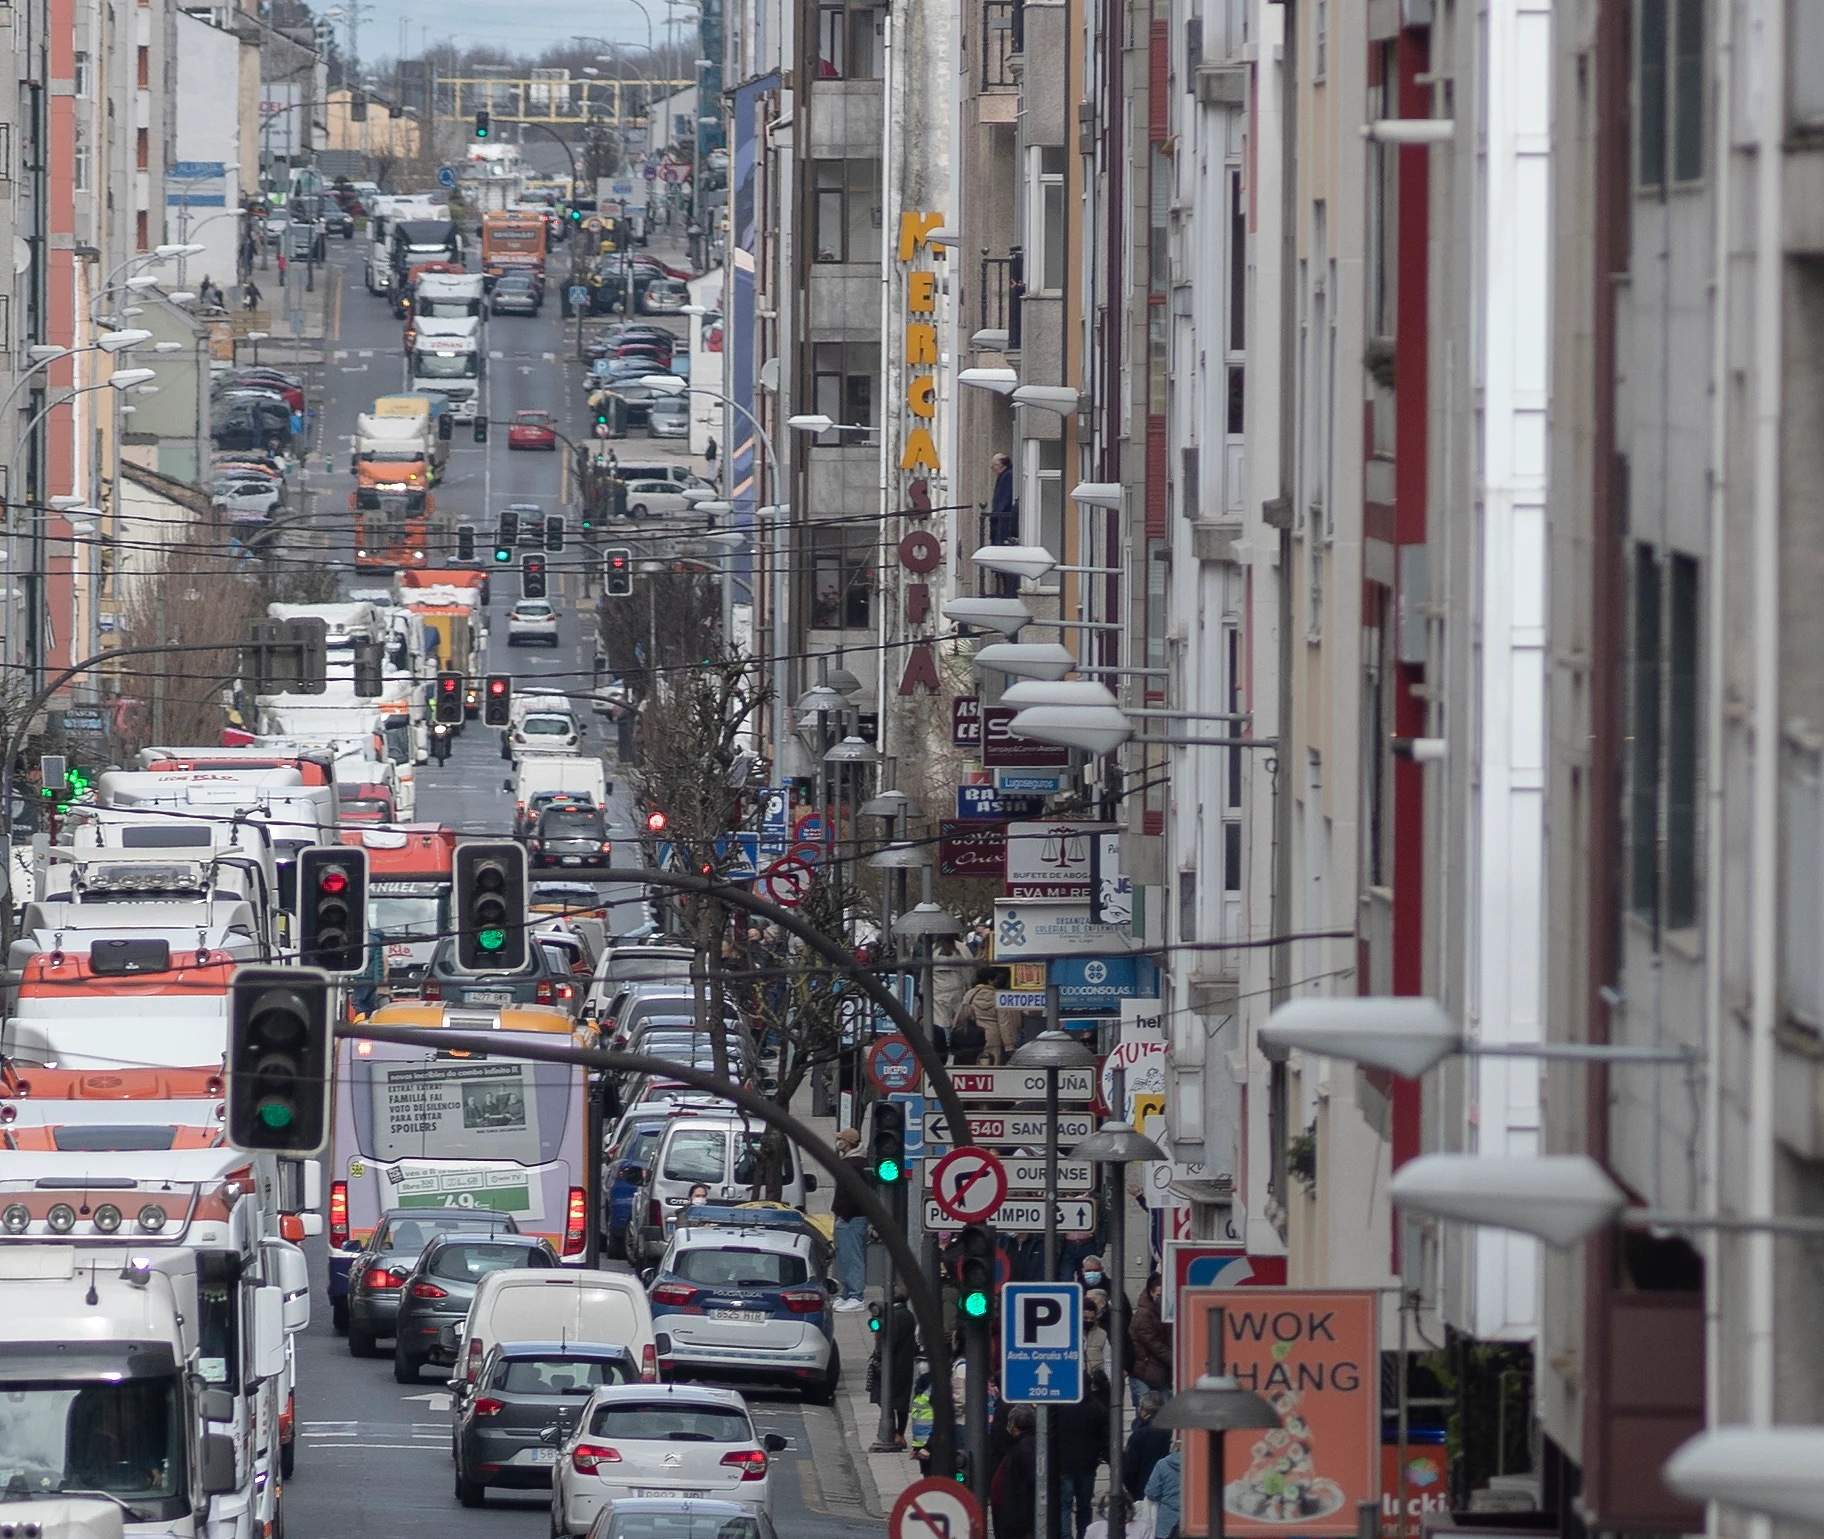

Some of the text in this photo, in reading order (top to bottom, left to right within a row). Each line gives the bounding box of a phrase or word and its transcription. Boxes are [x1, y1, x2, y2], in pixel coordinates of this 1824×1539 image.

[1013, 888, 1045, 897] EVA
[953, 1074, 1088, 1090] N-VI COUÑA
[389, 1094, 425, 1104] FAMILIA
[389, 1102, 461, 1113] VOTO DE SILENCIO
[390, 1113, 411, 1123] PARA
[391, 1122, 437, 1134] SPOILERS
[1011, 1121, 1088, 1136] SANTAGO
[1016, 1167, 1088, 1181] OURNSE
[1023, 1297, 1062, 1344] P
[1228, 1312, 1336, 1342] WOK
[1206, 1361, 1360, 1392] HANG
